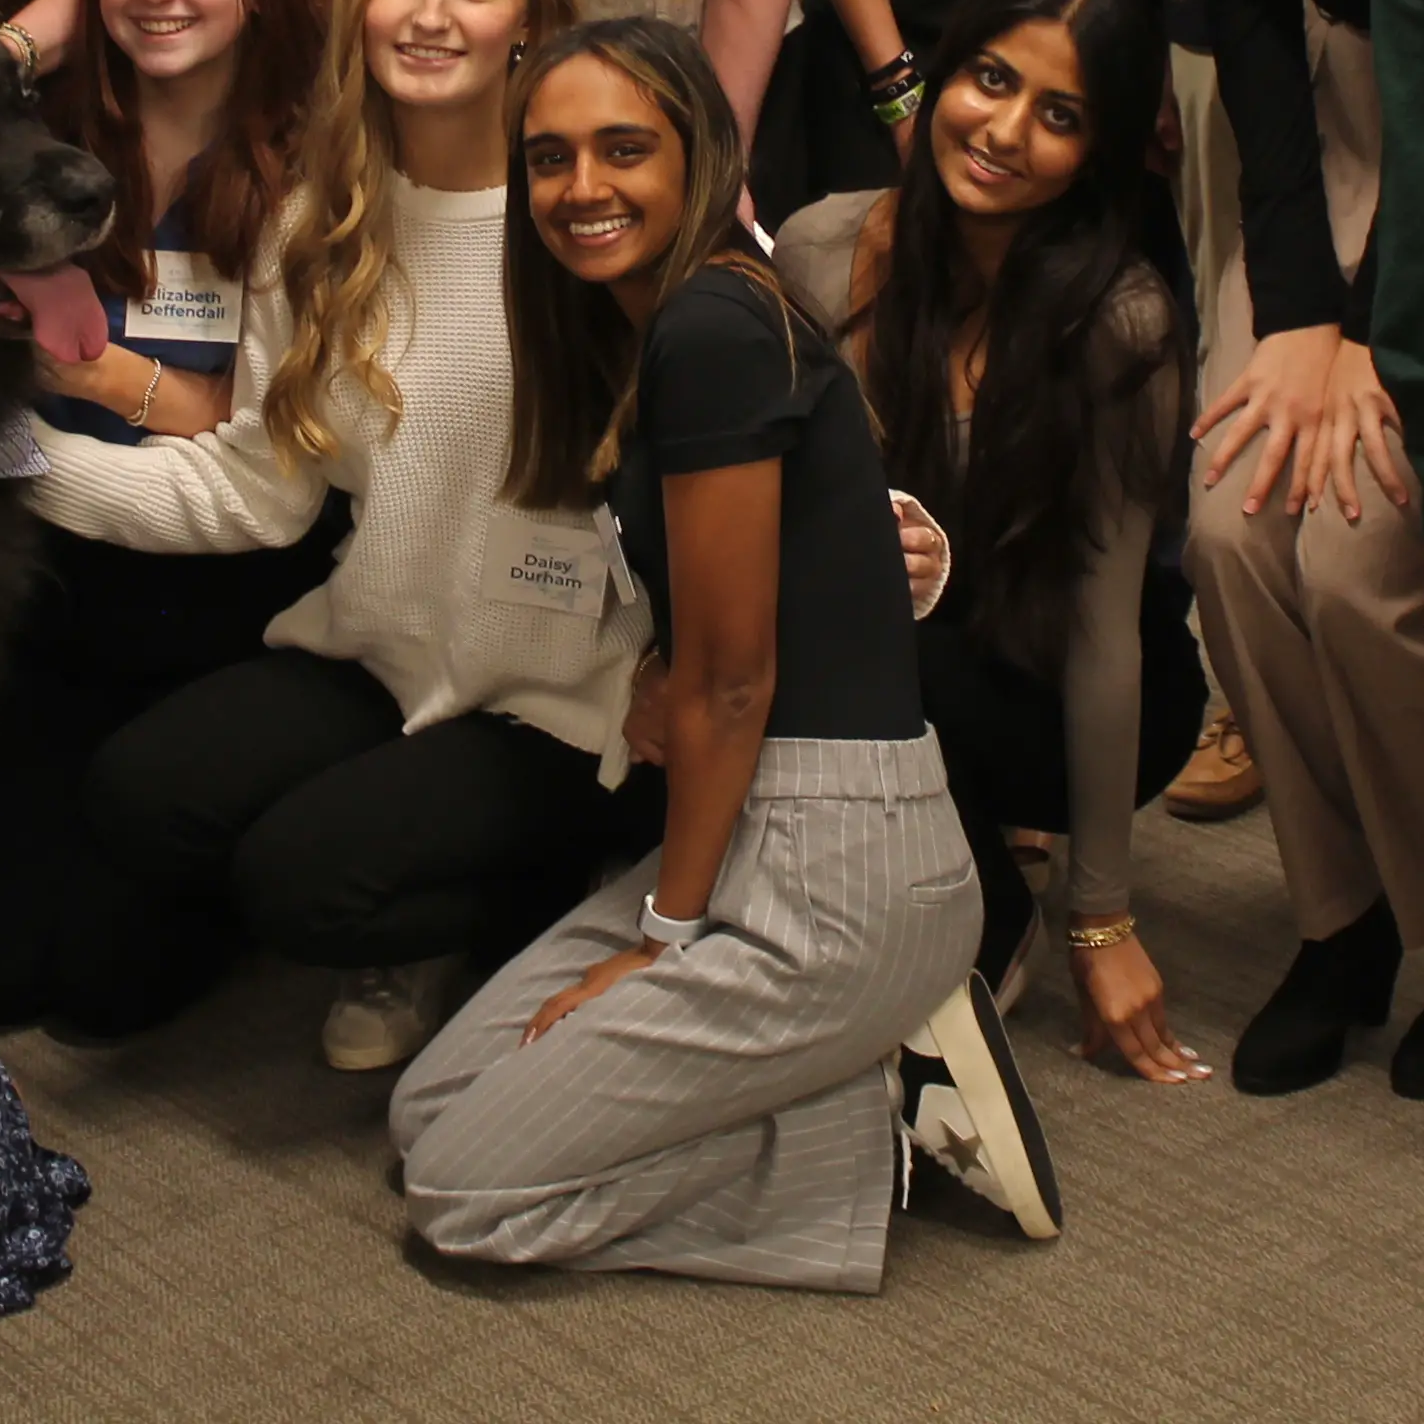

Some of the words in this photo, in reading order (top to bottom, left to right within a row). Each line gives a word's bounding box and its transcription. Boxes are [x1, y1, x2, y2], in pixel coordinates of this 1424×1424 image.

[141, 303, 225, 319] Deffendall
[524, 553, 573, 574] Daisy
[510, 567, 582, 589] Durham
